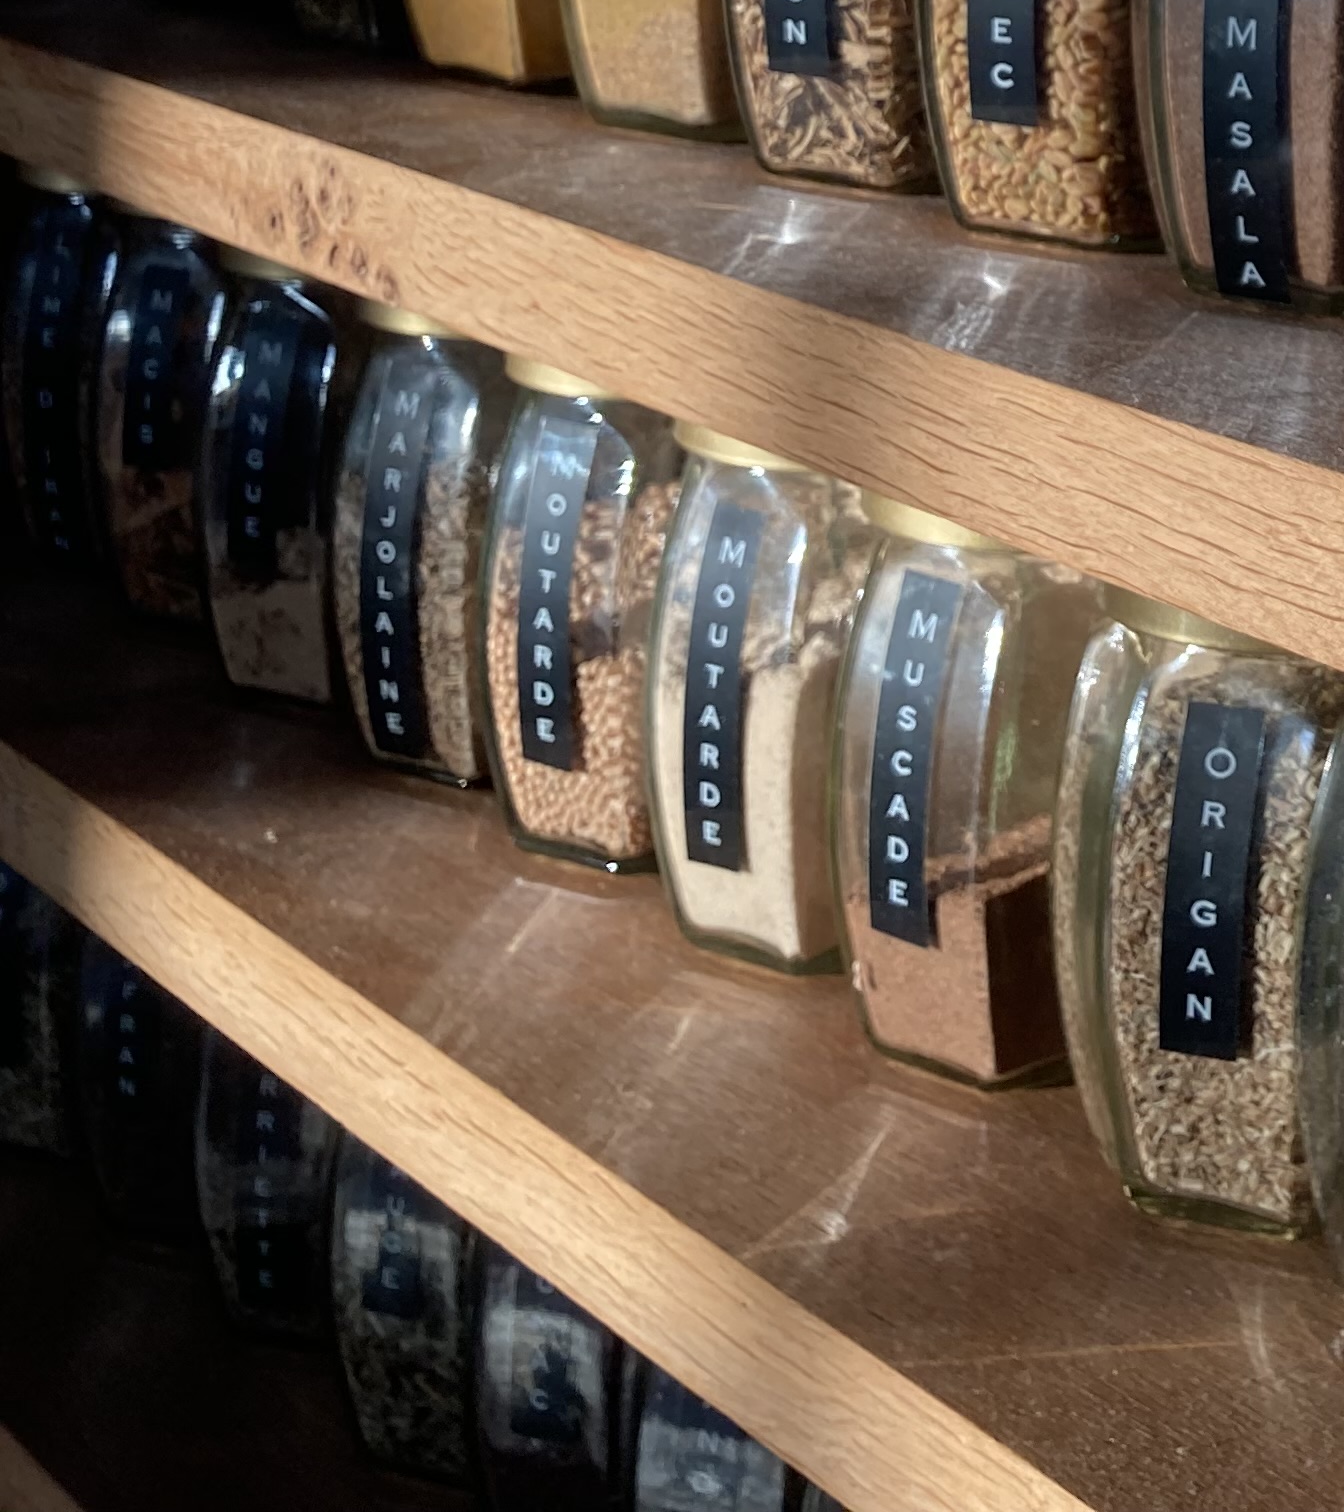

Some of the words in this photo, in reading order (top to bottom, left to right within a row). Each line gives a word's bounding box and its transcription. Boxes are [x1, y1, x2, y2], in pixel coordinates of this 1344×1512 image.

[1226, 18, 1267, 287] MASALA
[139, 288, 173, 447] MACIS
[244, 340, 283, 538] MANGUE
[375, 392, 421, 734] MARJOLAINE
[532, 451, 580, 743] MOUTARDE
[698, 537, 747, 847] MOUTARDE
[886, 609, 939, 907] MUSCADE
[1186, 747, 1237, 1022] ORIGAN
